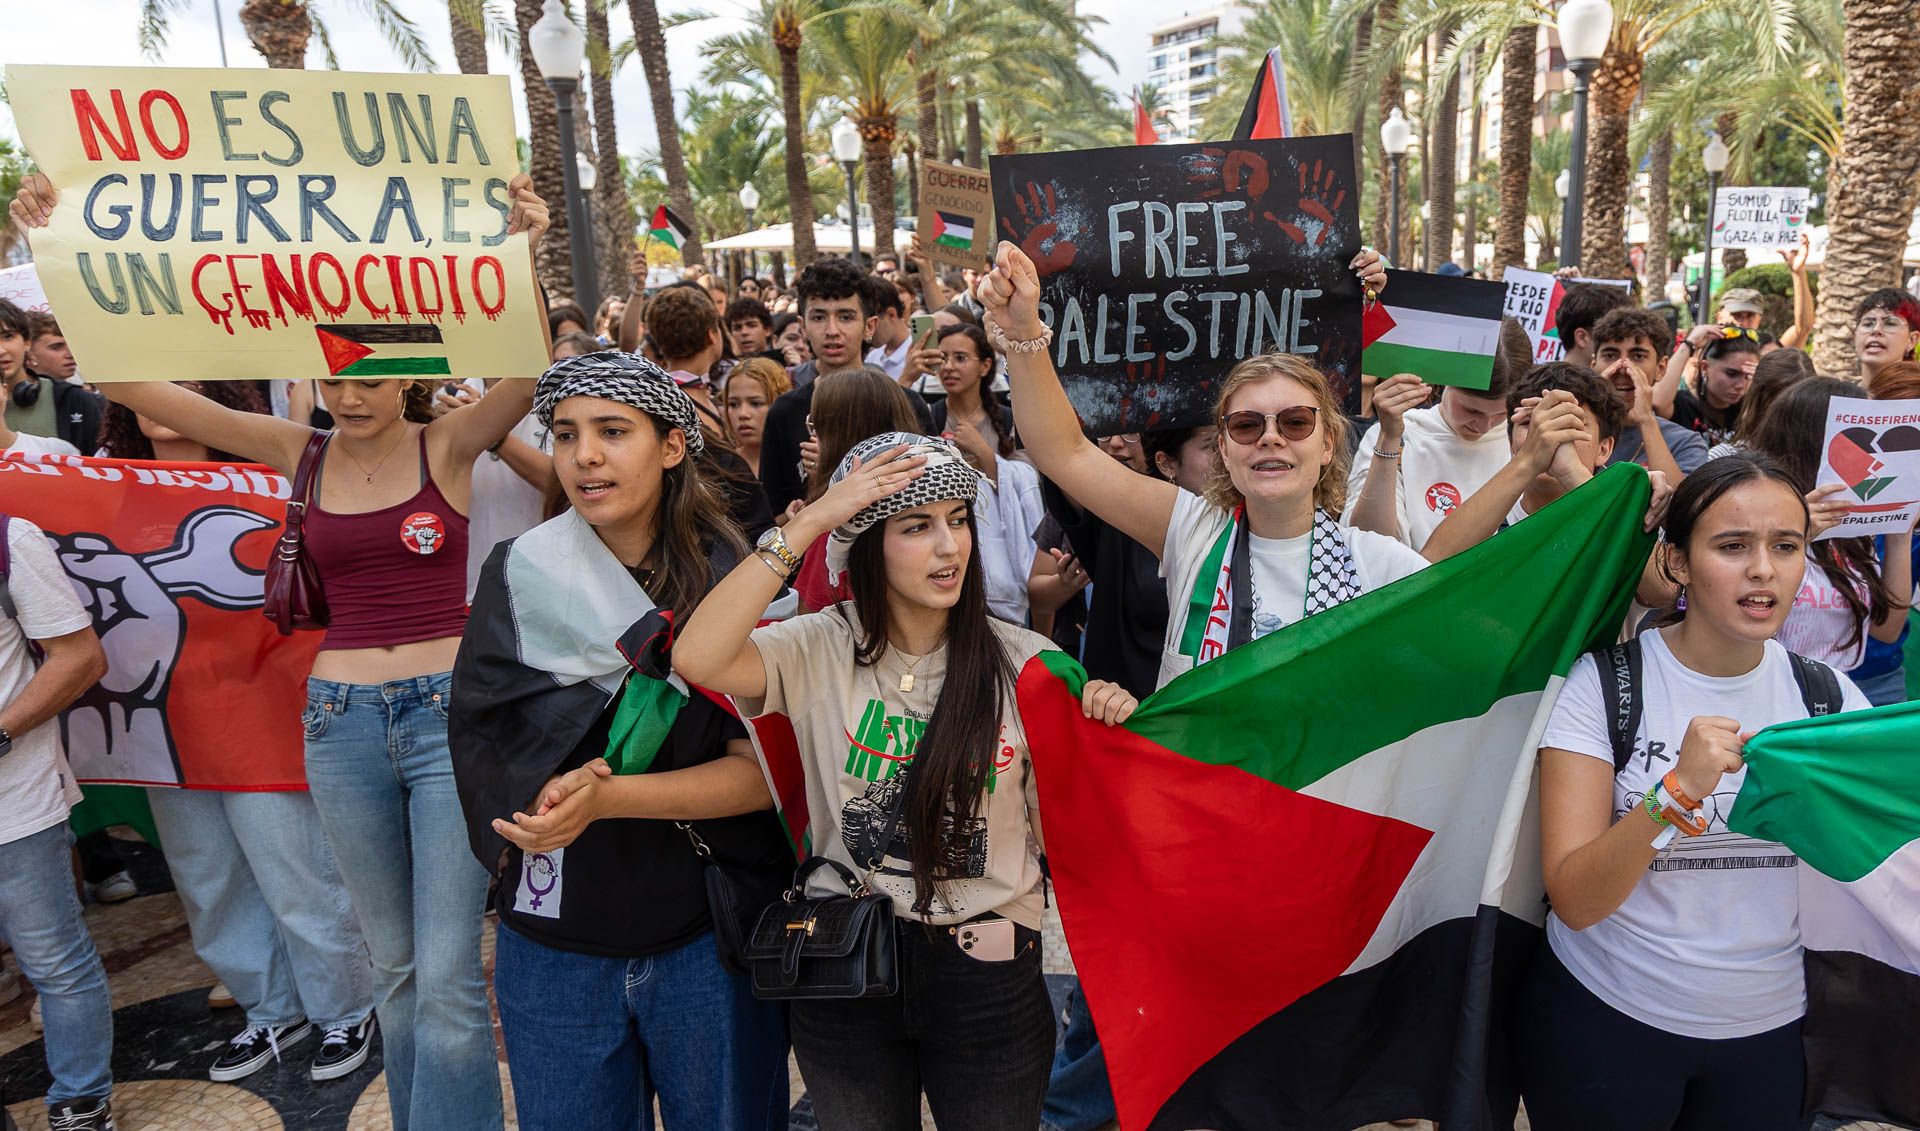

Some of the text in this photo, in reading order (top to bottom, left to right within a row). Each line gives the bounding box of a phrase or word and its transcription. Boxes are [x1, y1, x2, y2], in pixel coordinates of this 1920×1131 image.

[70, 89, 491, 167] NO ES UNA
[928, 169, 988, 194] GUERRA
[1728, 193, 1771, 207] SUMUD
[1728, 209, 1778, 224] FLOTILLA
[1107, 200, 1250, 278] FREE
[1723, 229, 1798, 244] GAZA EN PAZ
[76, 251, 506, 335] UN GENOCIDIO
[1506, 281, 1548, 300] ESDE
[1835, 413, 1920, 426] #CEASEFIREN
[1841, 513, 1910, 525] EPALESTINE
[1612, 646, 1632, 731] OGWARTS
